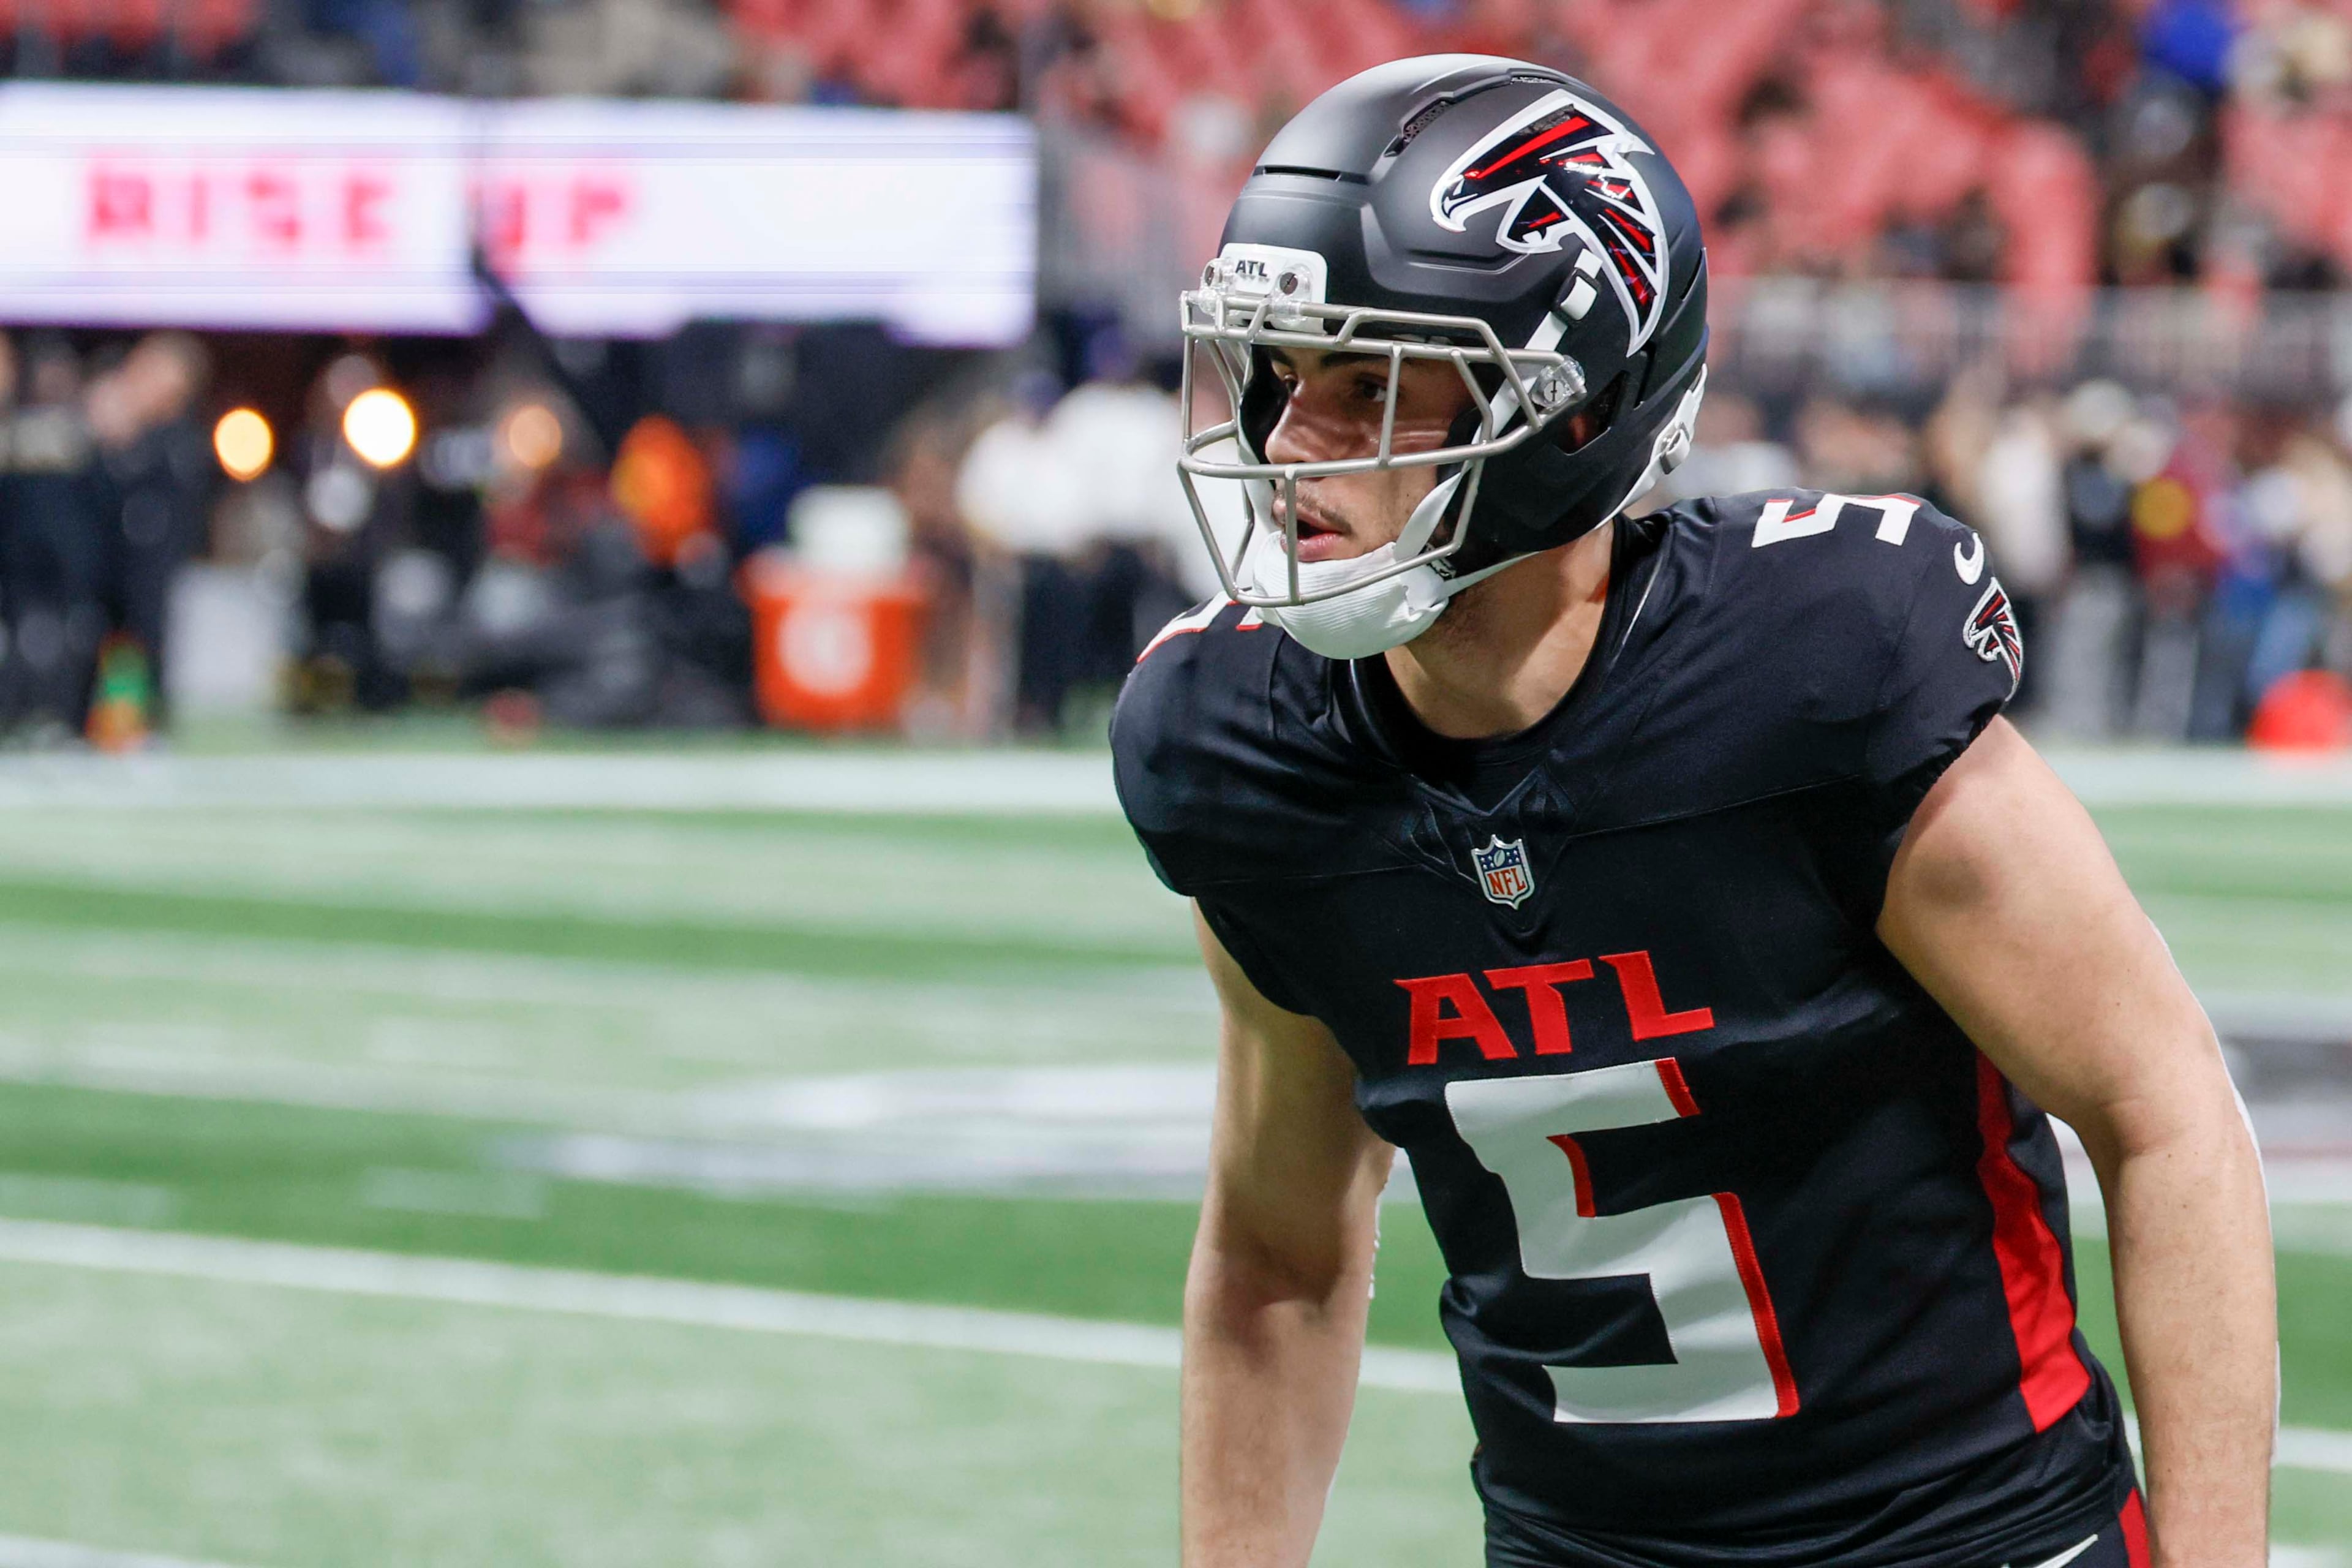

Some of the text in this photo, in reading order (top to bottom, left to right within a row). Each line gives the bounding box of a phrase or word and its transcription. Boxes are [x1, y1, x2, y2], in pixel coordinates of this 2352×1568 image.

[89, 167, 393, 246] RISE
[1235, 260, 1267, 277] ATL
[1751, 493, 1921, 548] 5
[1487, 867, 1527, 896] NFL
[1393, 950, 1714, 1066] ATL
[1445, 1057, 1800, 1423] 5
